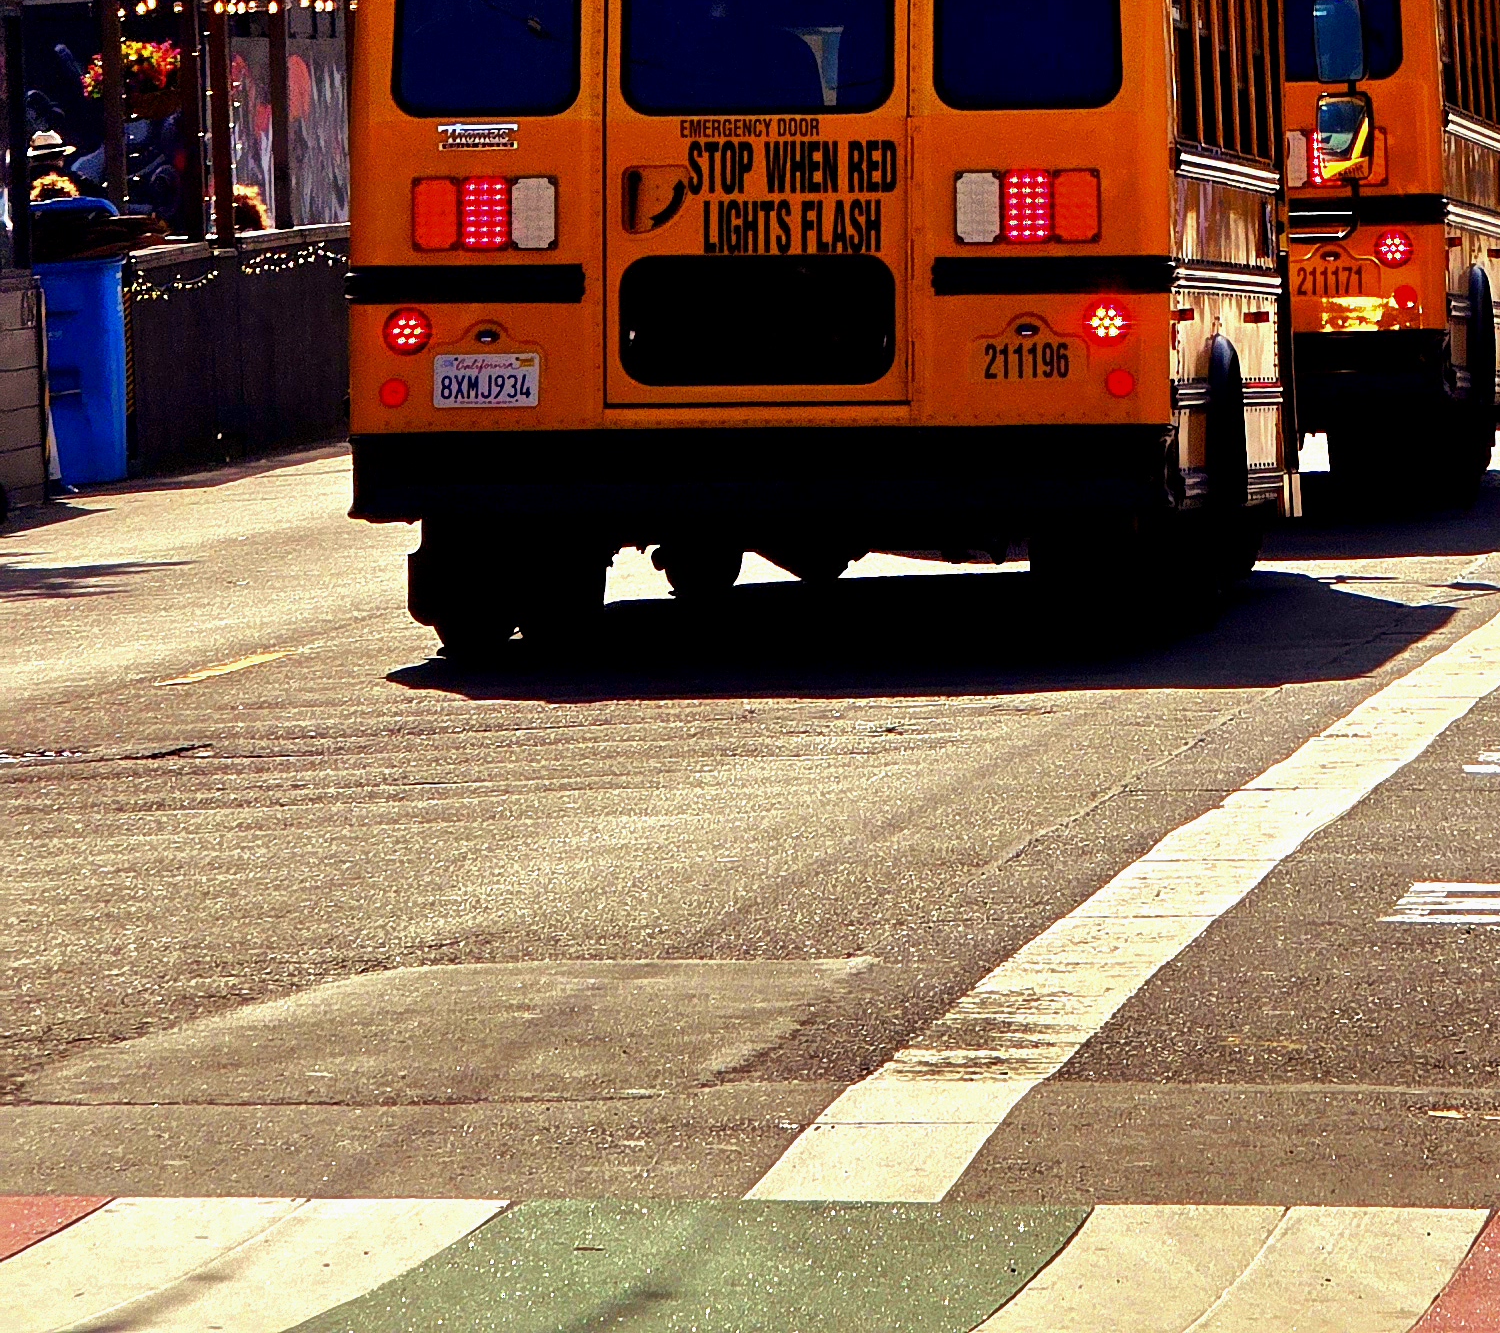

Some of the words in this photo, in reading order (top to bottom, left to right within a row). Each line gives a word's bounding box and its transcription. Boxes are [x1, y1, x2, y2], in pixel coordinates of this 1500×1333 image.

[680, 118, 772, 138] EMERGENCY
[777, 118, 820, 137] DOOR
[688, 140, 754, 195] STOP
[764, 140, 838, 194] WHEN
[847, 139, 897, 193] RED
[703, 199, 792, 254] LIGHTS
[801, 198, 882, 254] FLASH
[1296, 266, 1363, 296] 211171
[456, 358, 520, 374] California
[984, 342, 1069, 379] 211196
[441, 374, 531, 400] 8XMJ934
